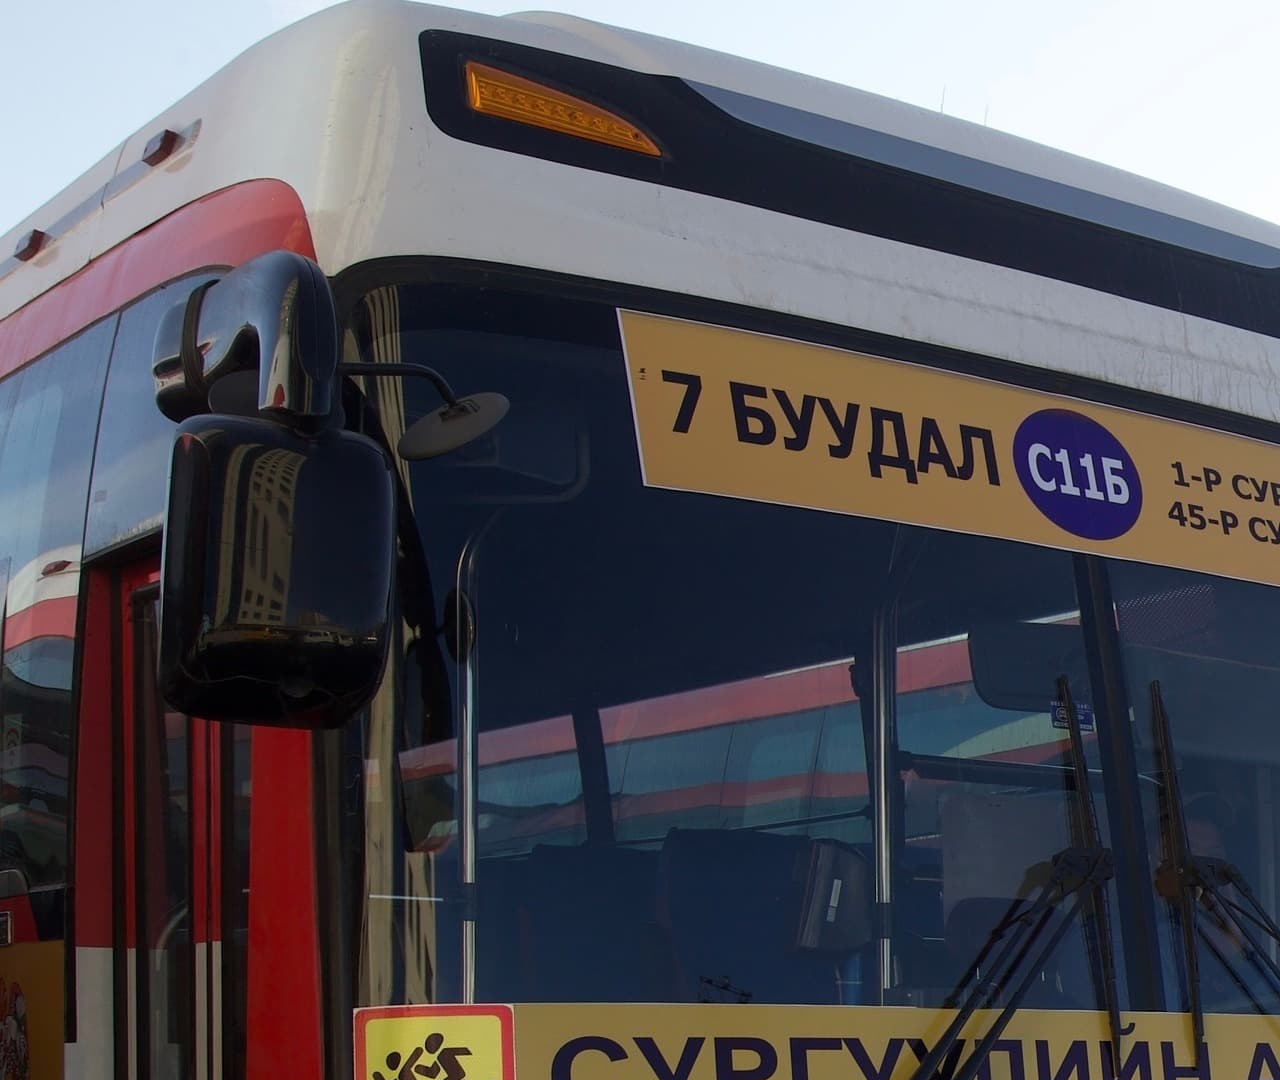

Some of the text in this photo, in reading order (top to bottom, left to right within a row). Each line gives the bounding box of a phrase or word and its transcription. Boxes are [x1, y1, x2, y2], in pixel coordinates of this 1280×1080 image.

[661, 369, 1001, 487] 7 БУУДАЛ
[1027, 442, 1130, 506] С11Б
[1170, 460, 1222, 493] 1-Р
[1167, 500, 1239, 537] 45-Р
